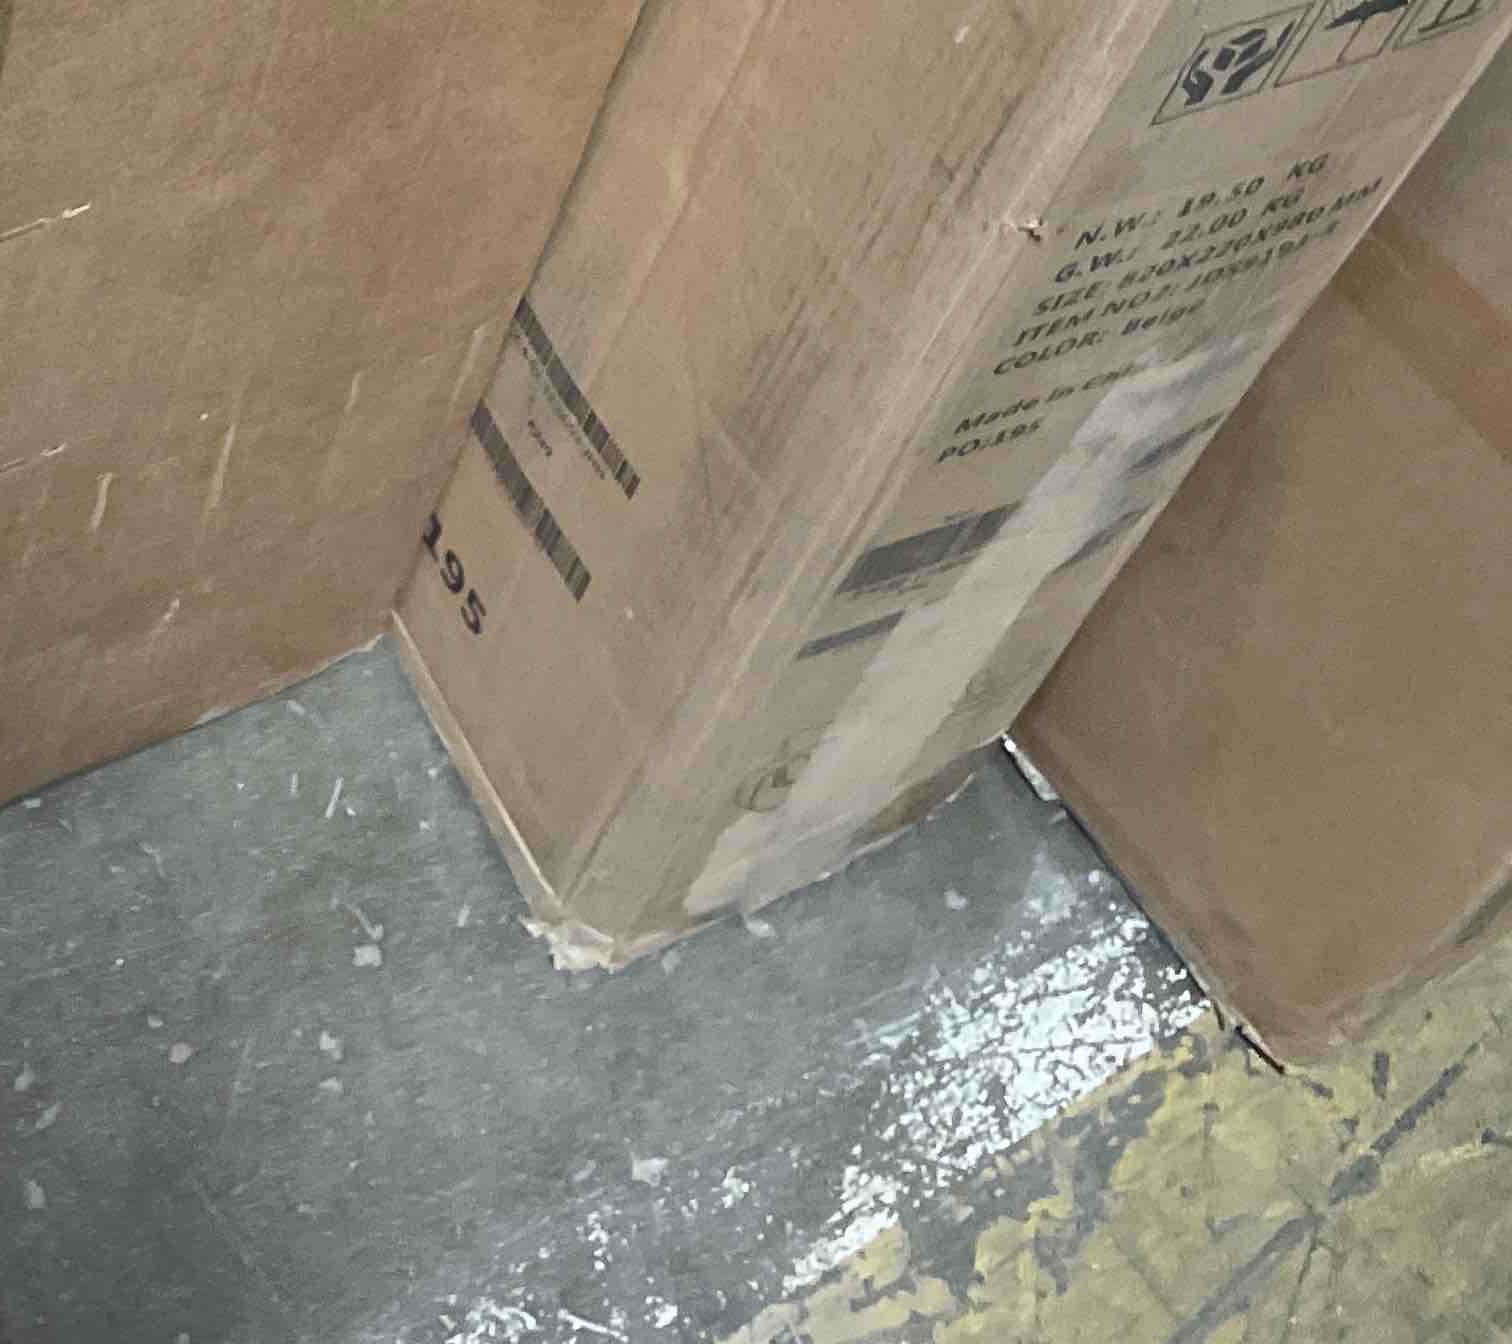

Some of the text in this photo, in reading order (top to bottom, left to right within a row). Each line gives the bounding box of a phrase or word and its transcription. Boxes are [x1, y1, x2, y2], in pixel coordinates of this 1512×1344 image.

[1288, 152, 1329, 180] KG
[1161, 208, 1248, 249] 22.00
[1262, 188, 1306, 217] KG
[993, 298, 1207, 375] COLOR: Beige
[953, 399, 1040, 436] Made
[423, 510, 487, 634] 195
